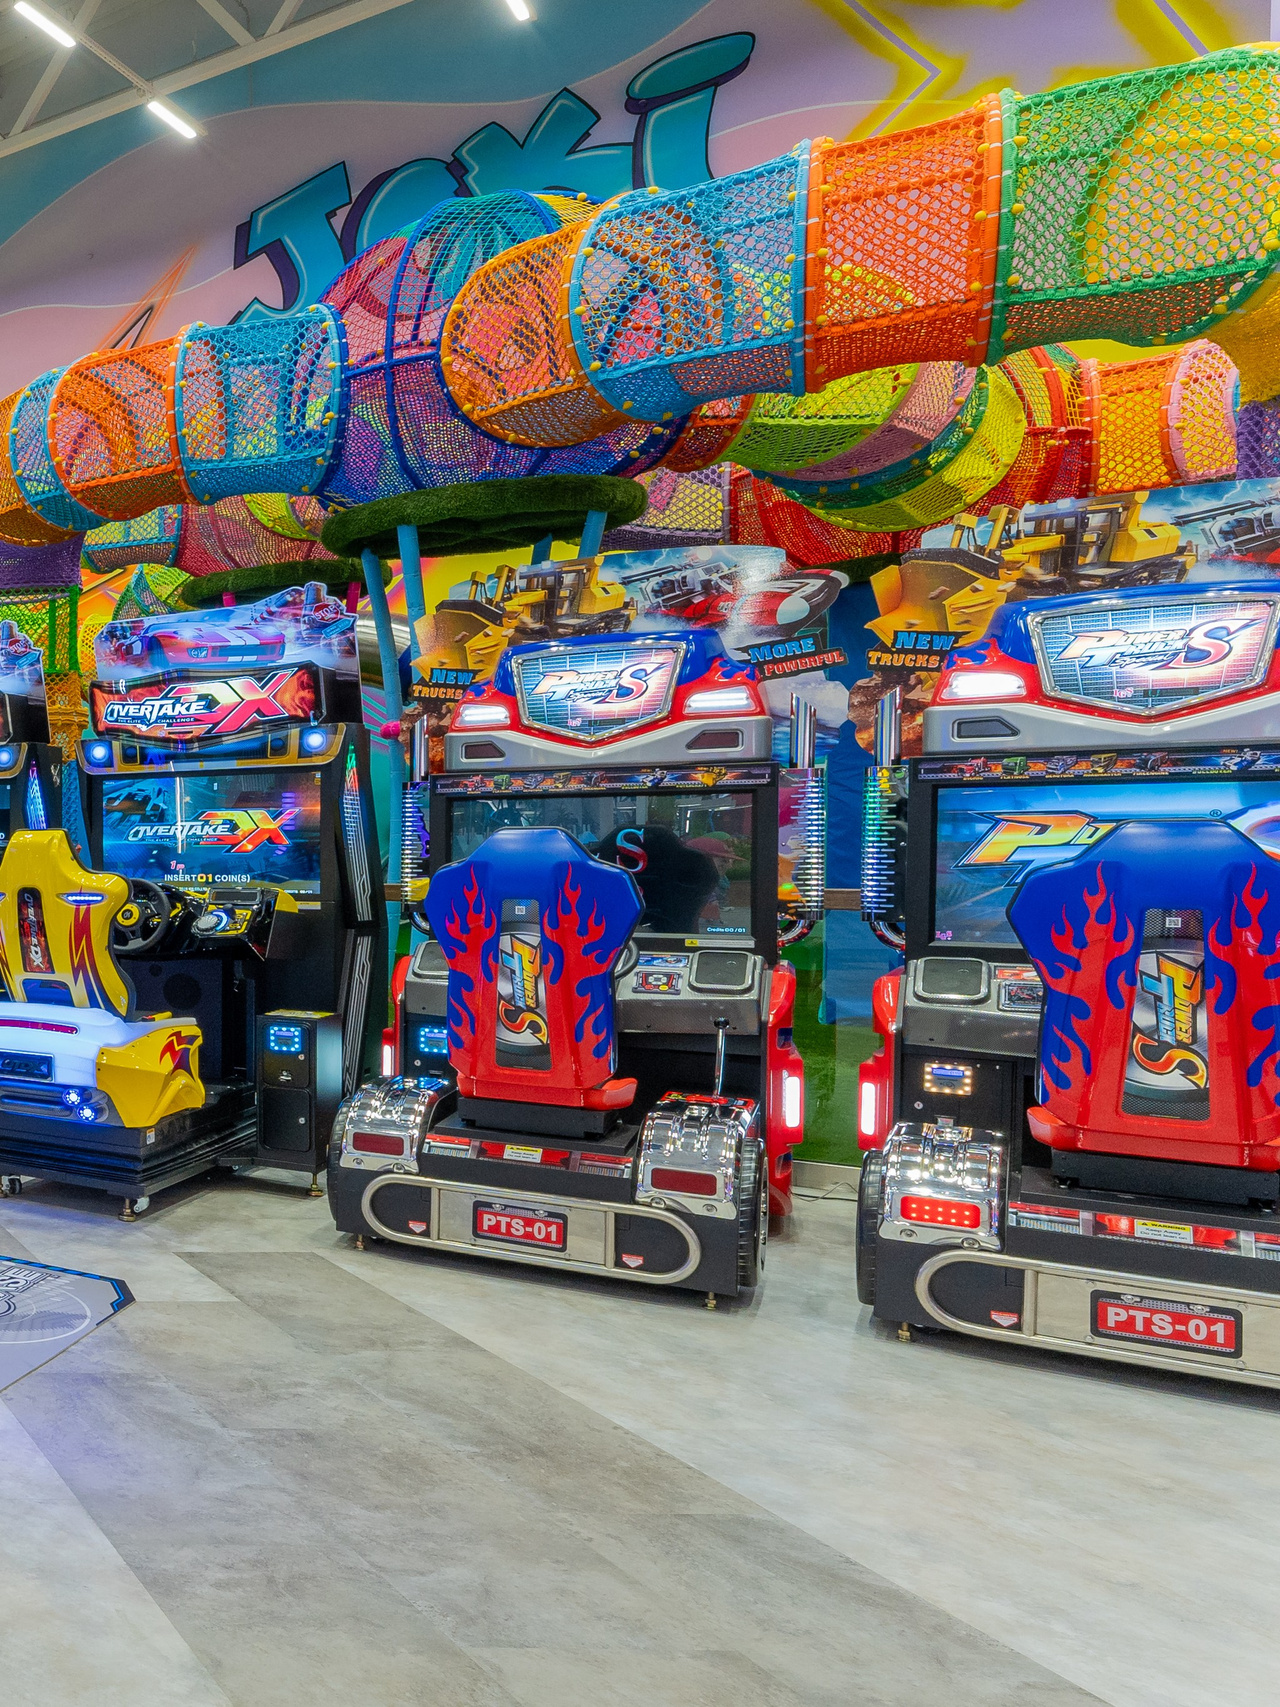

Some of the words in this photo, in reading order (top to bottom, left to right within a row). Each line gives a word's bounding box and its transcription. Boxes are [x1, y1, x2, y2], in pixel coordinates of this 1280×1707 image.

[314, 604, 336, 619] STOP
[748, 637, 816, 663] MORE
[894, 631, 956, 650] NEW
[1053, 629, 1188, 661] POWER
[1081, 640, 1189, 669] TRUCK
[763, 650, 845, 677] POWERFUL
[867, 650, 940, 668] TRUCKS
[431, 668, 474, 685] NEW
[529, 670, 620, 695] POWER
[168, 668, 299, 736] DX
[412, 684, 464, 700] TRUCKS
[198, 808, 302, 854] DX
[164, 874, 197, 882] INSERT
[197, 873, 213, 882] 01
[214, 873, 251, 883] COIN(S)
[511, 936, 542, 1009] POWER
[1142, 974, 1176, 1046] TRUCK
[1158, 955, 1202, 1045] POWER
[499, 999, 549, 1045] S
[1132, 1032, 1208, 1090] S
[482, 1213, 557, 1242] PTS-01
[1150, 1223, 1186, 1231] WARNING
[1106, 1305, 1226, 1344] PTS-01
